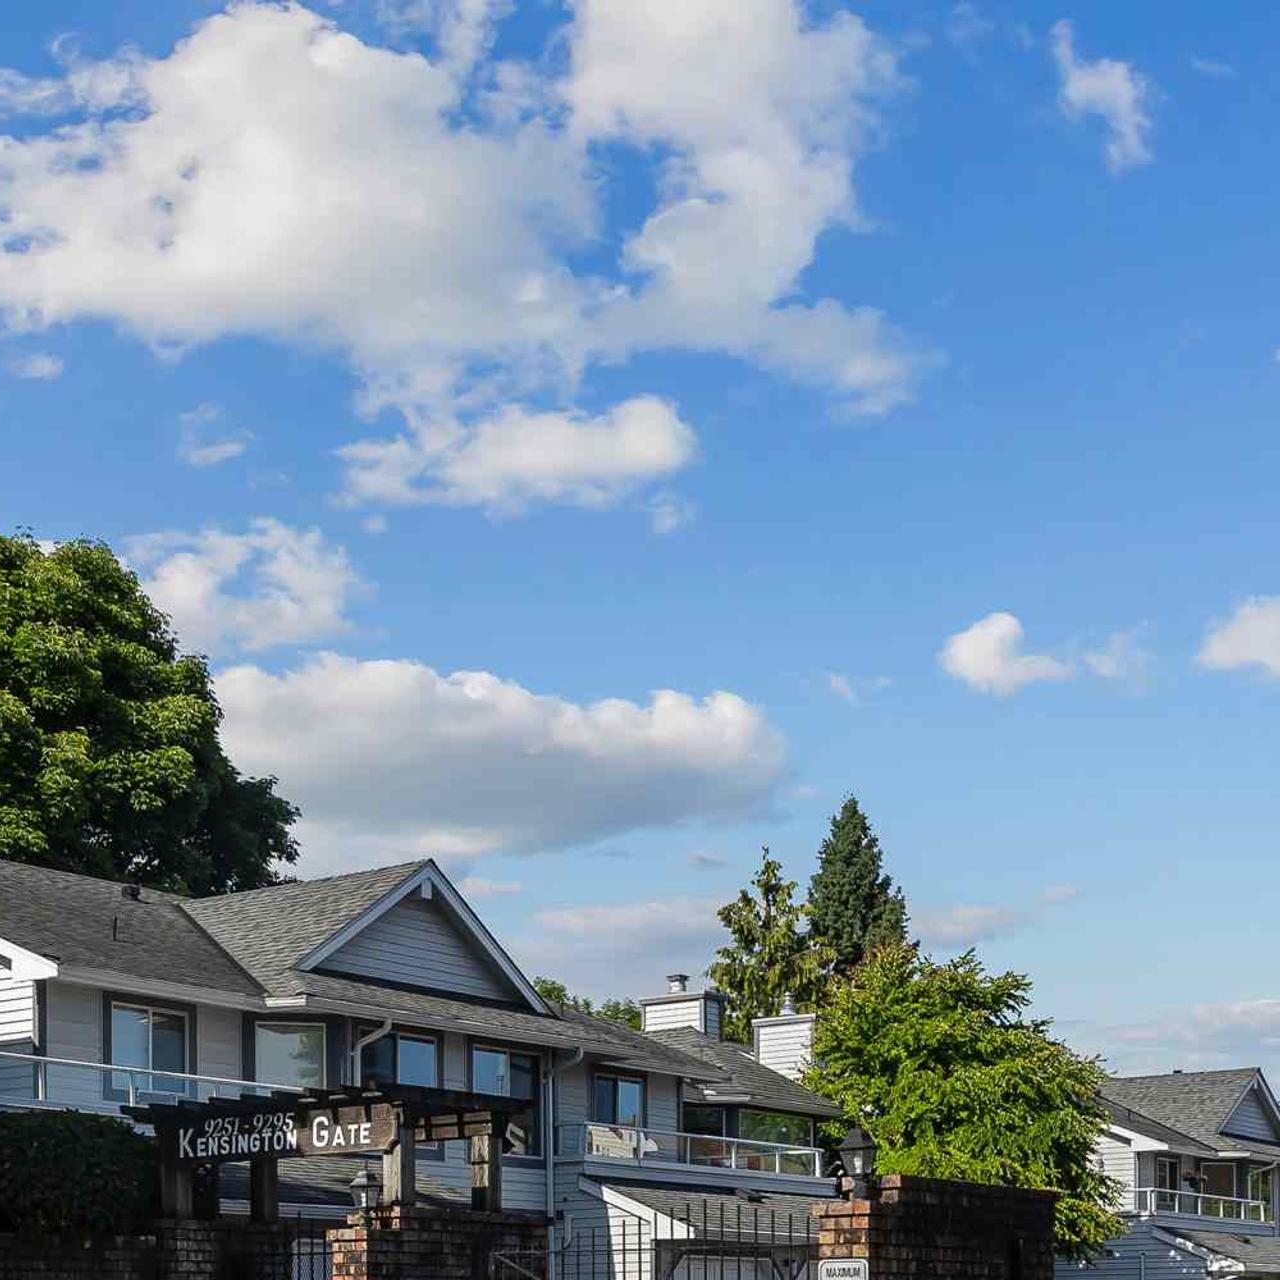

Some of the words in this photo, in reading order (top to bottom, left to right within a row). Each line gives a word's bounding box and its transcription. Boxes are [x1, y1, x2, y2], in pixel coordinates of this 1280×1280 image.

[179, 1127, 297, 1158] KENSINGTON
[312, 1116, 371, 1147] GATE
[204, 1116, 239, 1138] 9251
[253, 1112, 296, 1133] 9295
[826, 1266, 861, 1279] MAXIMUM
